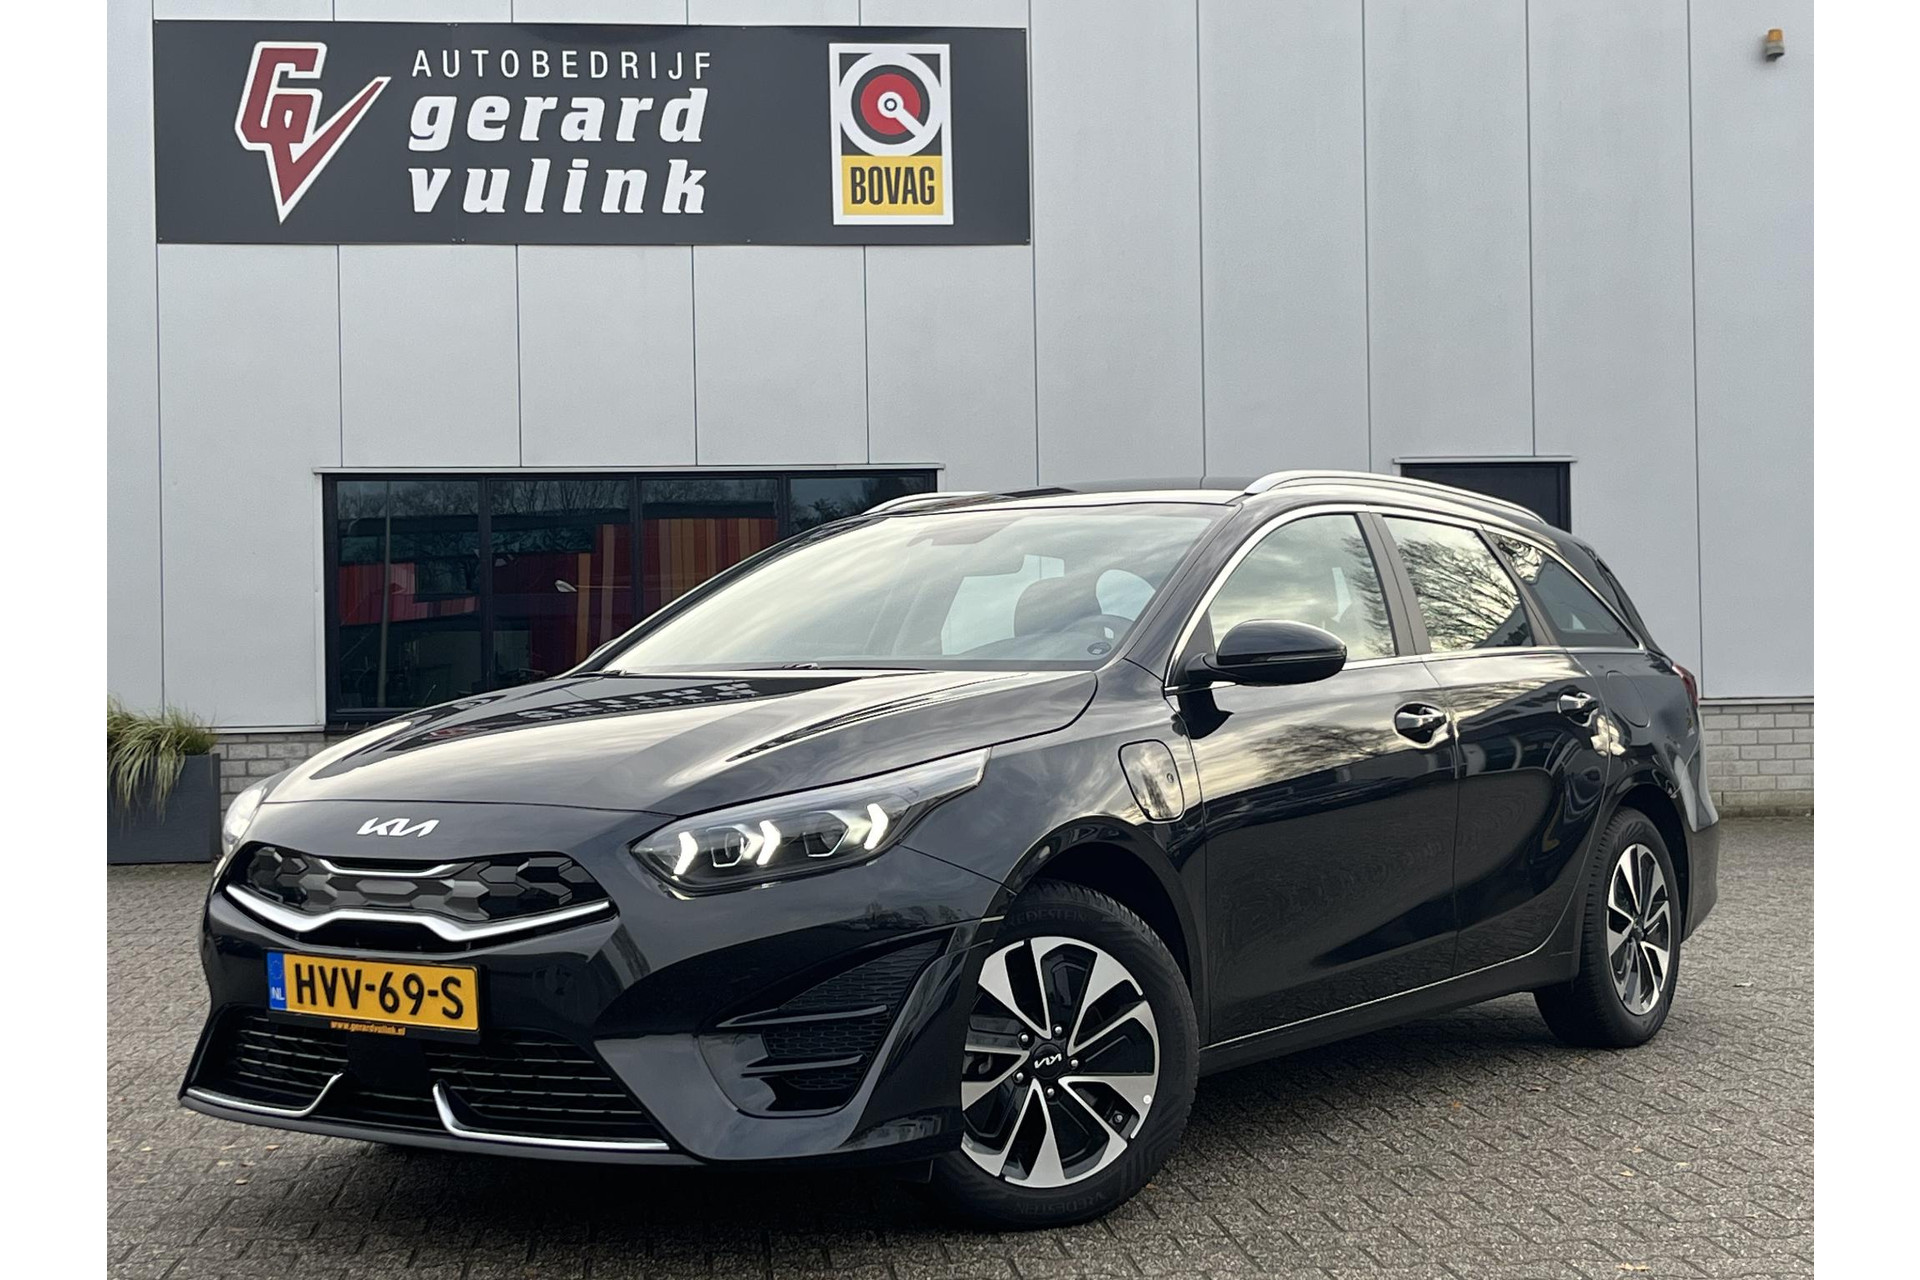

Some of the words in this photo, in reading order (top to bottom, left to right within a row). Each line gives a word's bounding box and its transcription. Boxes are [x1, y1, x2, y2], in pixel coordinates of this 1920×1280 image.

[412, 49, 711, 79] AUTOBEDRIJF
[409, 87, 709, 152] gerard
[408, 157, 707, 214] vulink
[850, 166, 935, 210] BOVAG
[357, 817, 440, 838] KIA
[271, 986, 285, 1001] NL
[294, 963, 464, 1020] HVV-69-S
